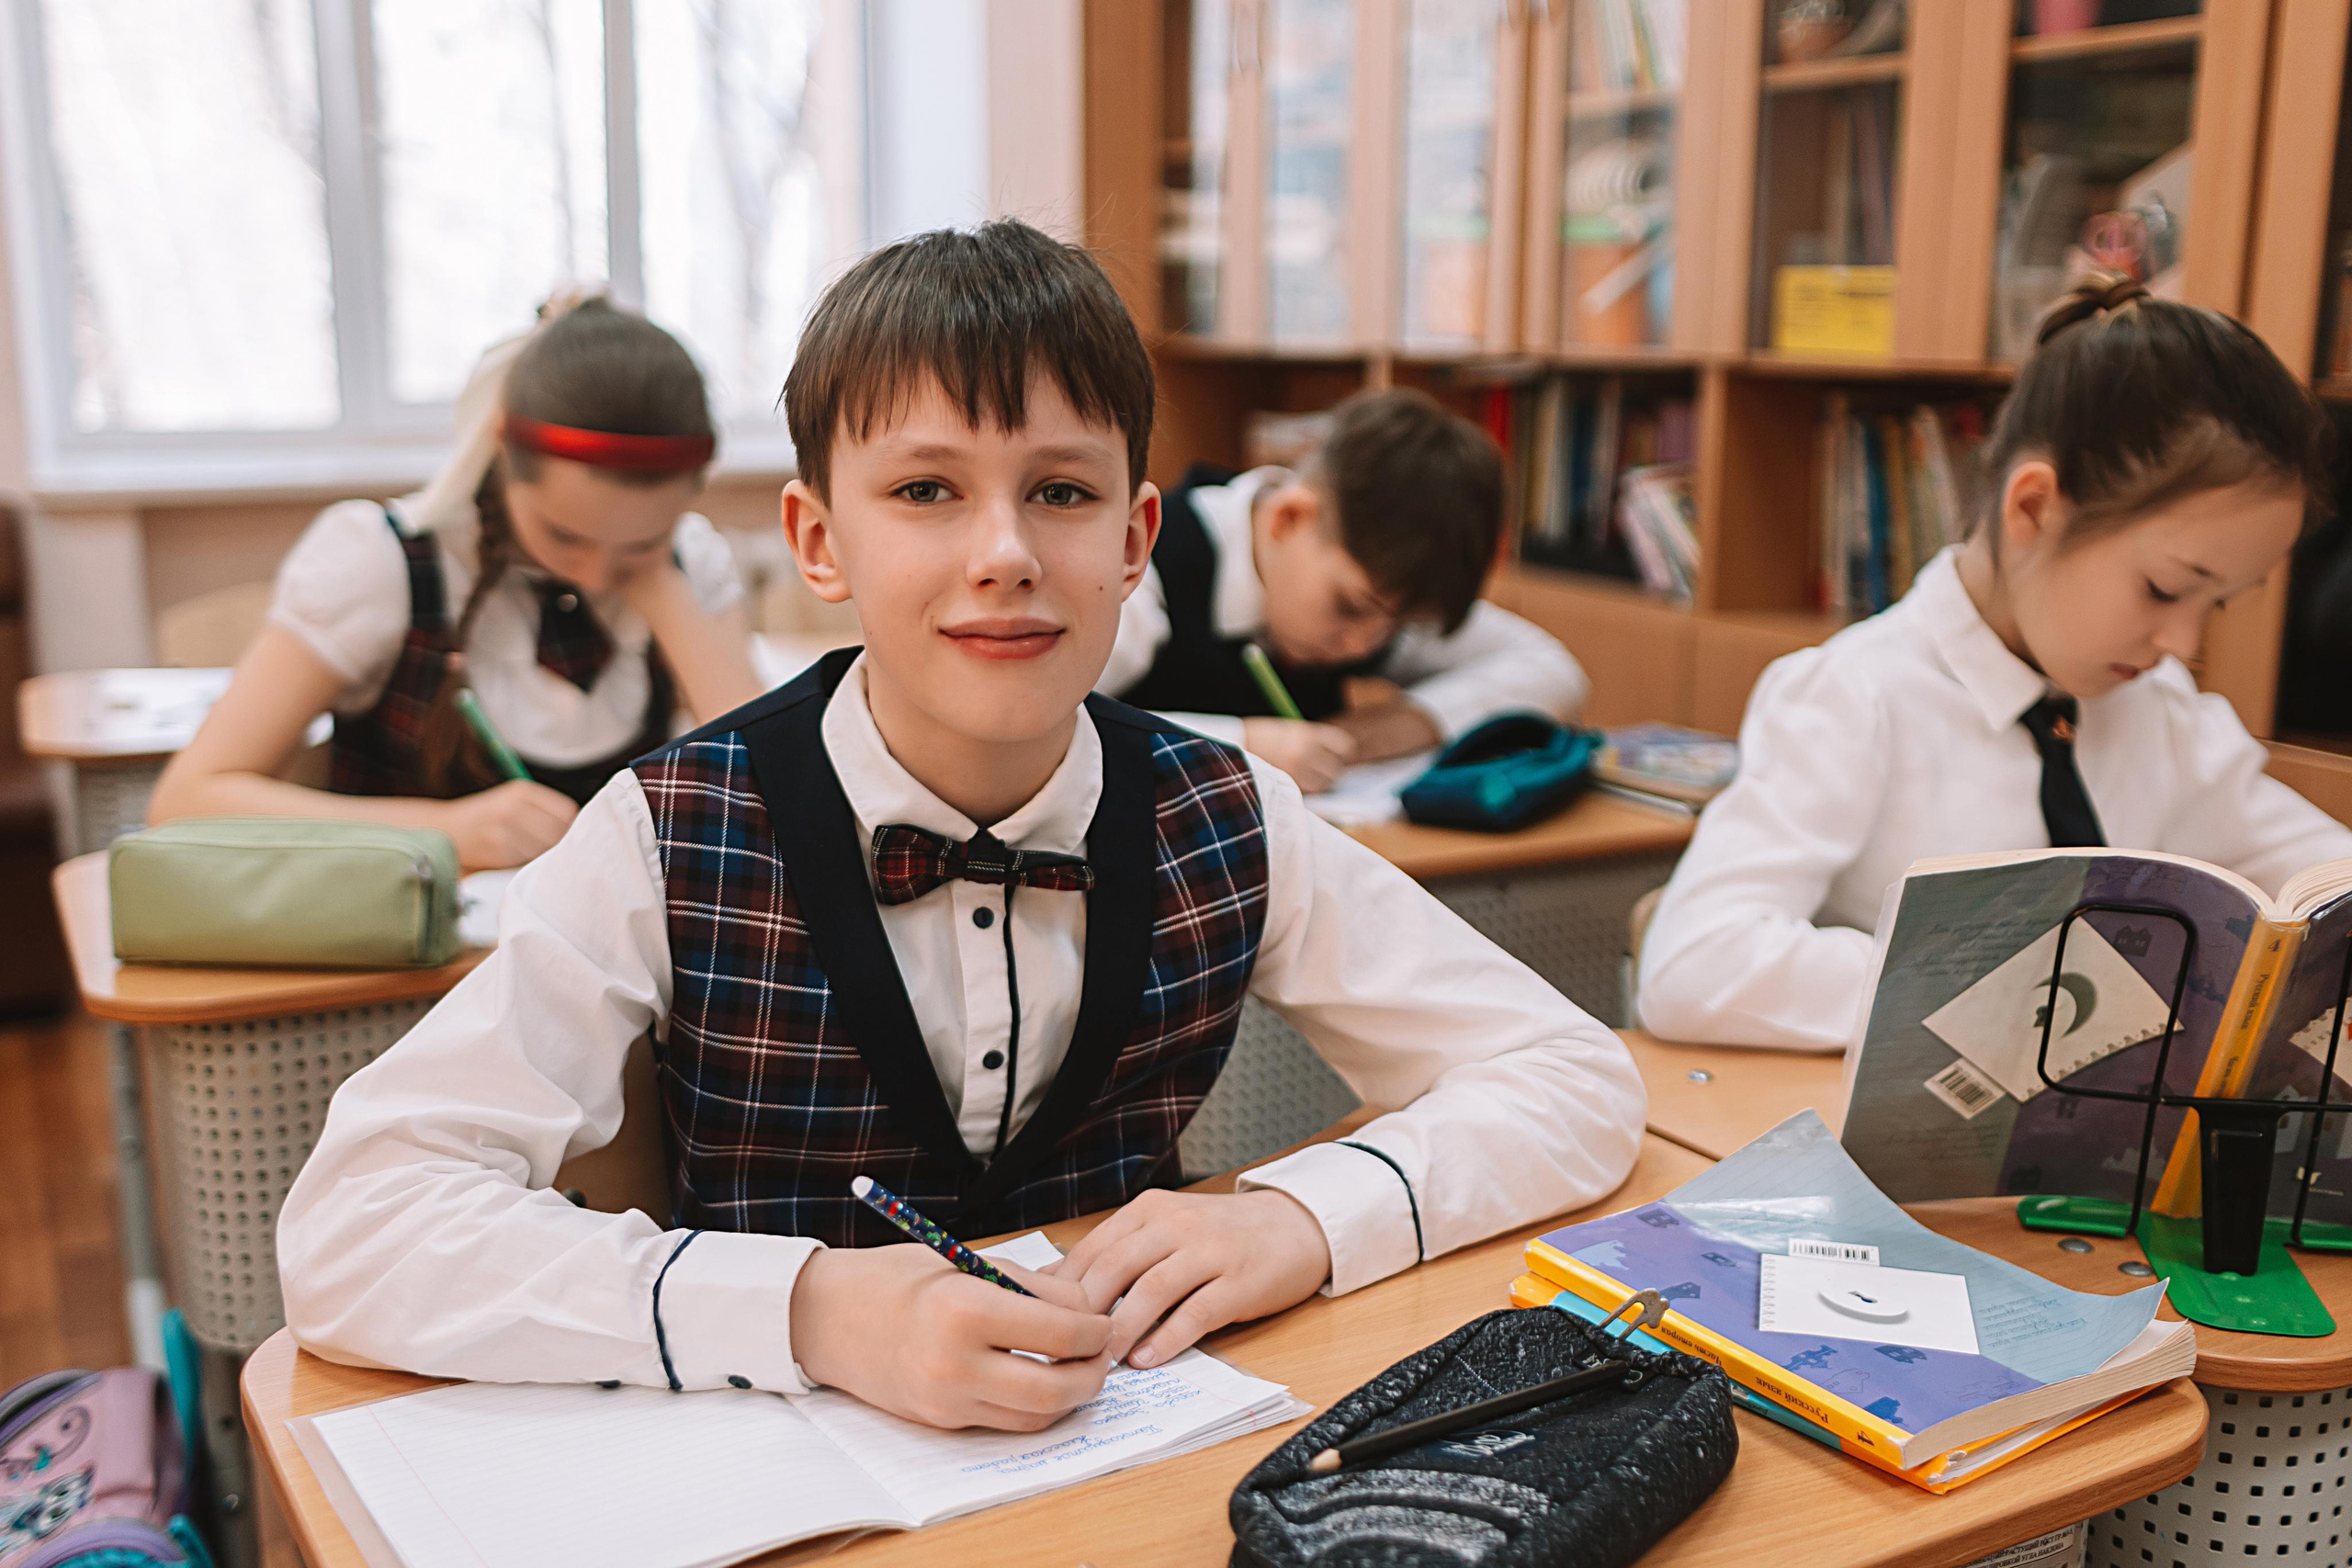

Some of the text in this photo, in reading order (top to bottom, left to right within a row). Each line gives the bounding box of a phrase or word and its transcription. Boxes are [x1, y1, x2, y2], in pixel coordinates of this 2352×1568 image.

[2267, 939, 2281, 953] 4
[1660, 1325, 1723, 1367] Часть вторая
[1756, 1377, 1782, 1396] язык
[1784, 1392, 1829, 1424] Русский
[1018, 1434, 1091, 1461] Классная
[1857, 1430, 1874, 1447] 4
[2021, 1551, 2038, 1562] УГЛА
[2038, 1541, 2064, 1558] НАКЛОНА
